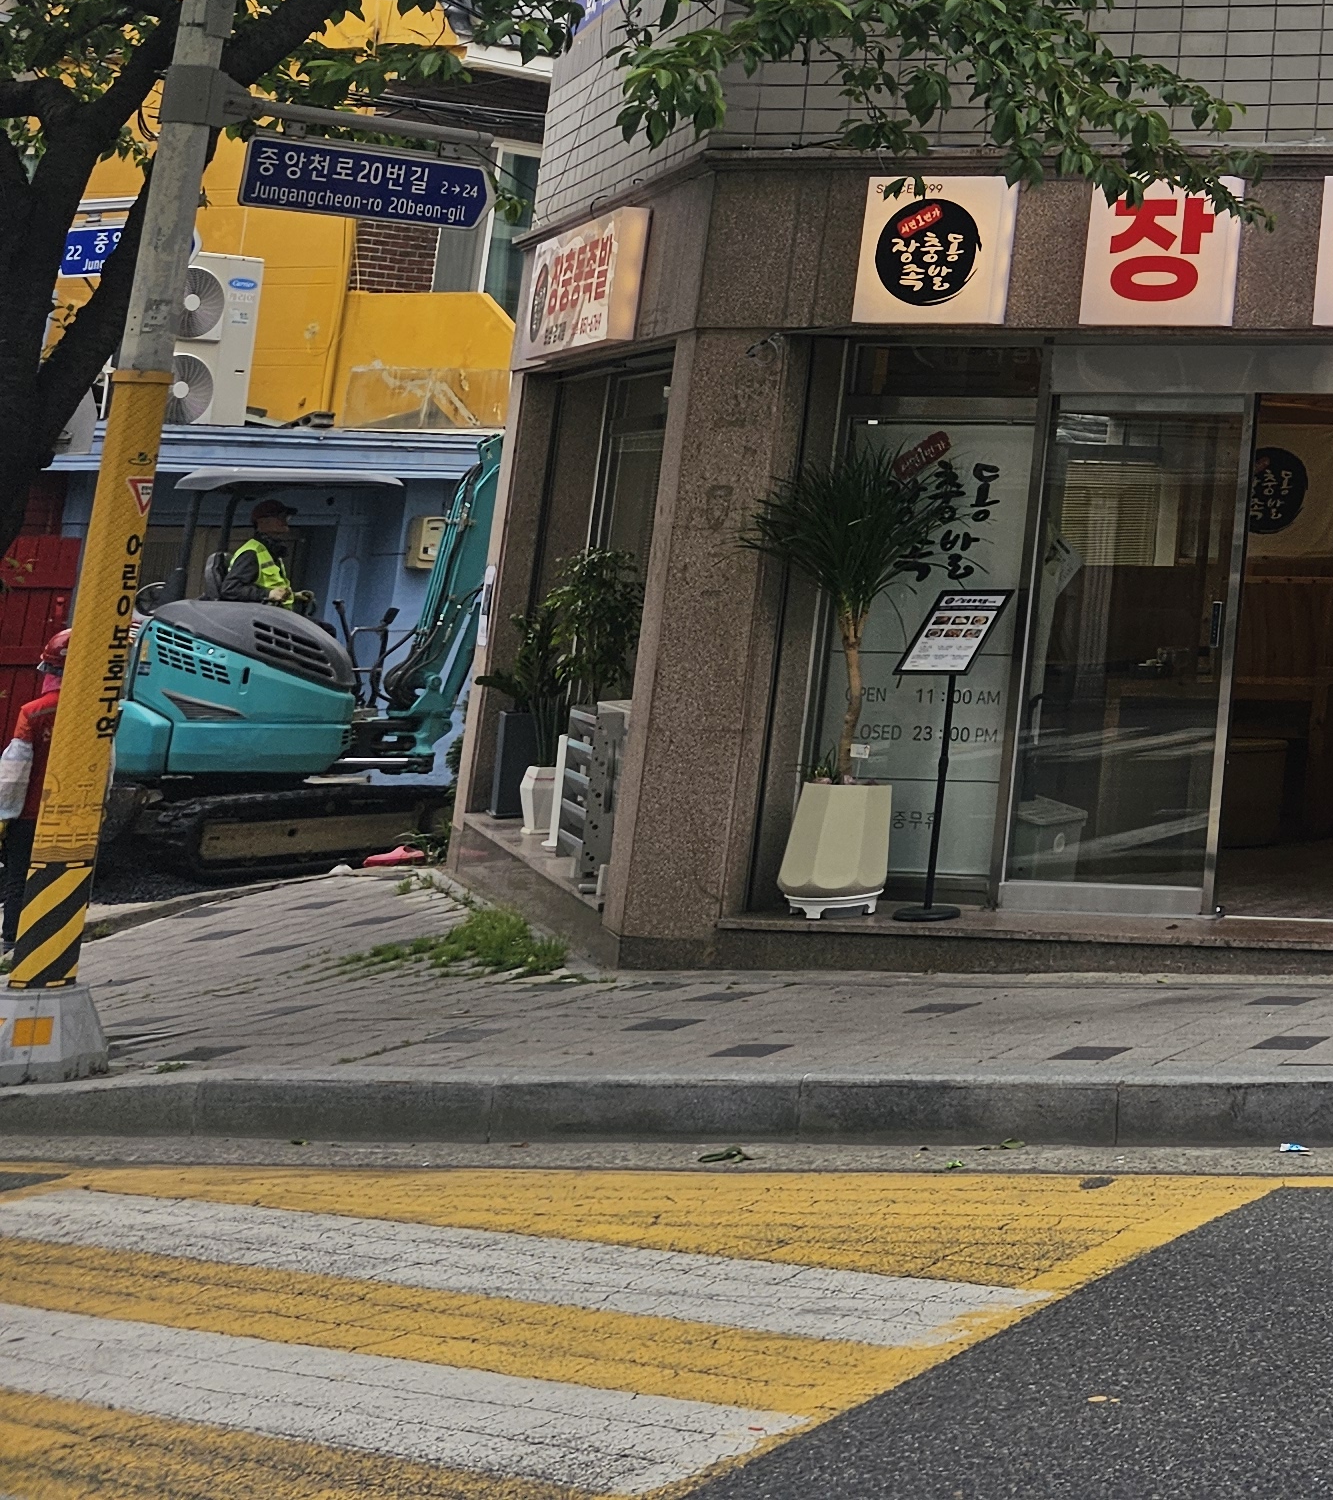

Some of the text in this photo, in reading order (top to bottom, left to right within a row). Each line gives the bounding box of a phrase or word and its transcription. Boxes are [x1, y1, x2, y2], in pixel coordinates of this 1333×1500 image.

[257, 148, 429, 194] 중앙천로20번길
[251, 182, 466, 222] Jungangcheon-ro 20beon-gil
[65, 245, 83, 261] 22
[891, 231, 964, 263] 장충동
[899, 264, 952, 291] 족발
[976, 690, 1001, 705] AM
[975, 728, 998, 742] PM
